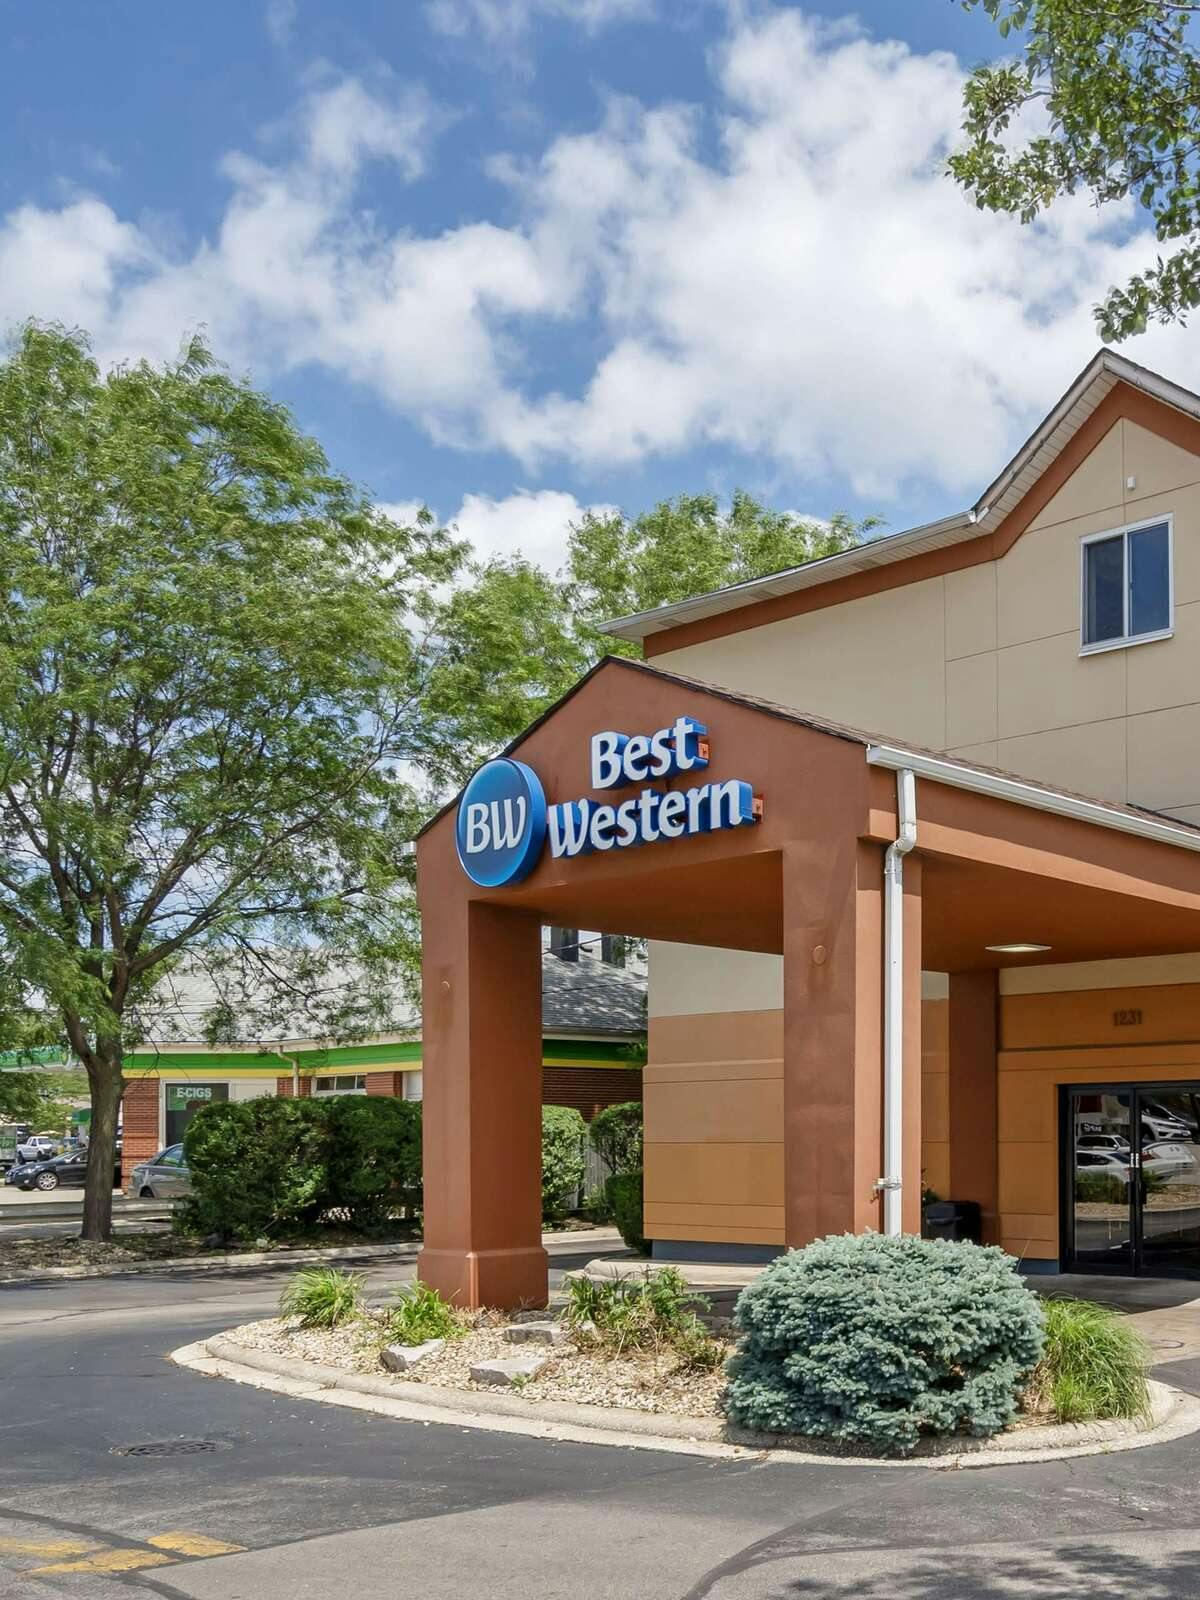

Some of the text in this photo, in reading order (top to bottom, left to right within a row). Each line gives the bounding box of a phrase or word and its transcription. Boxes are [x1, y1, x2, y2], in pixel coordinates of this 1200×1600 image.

[591, 716, 697, 789] Best
[465, 796, 526, 853] BW
[548, 779, 745, 859] Western
[1112, 1009, 1143, 1027] 1231
[176, 1087, 213, 1098] E-CIGS
